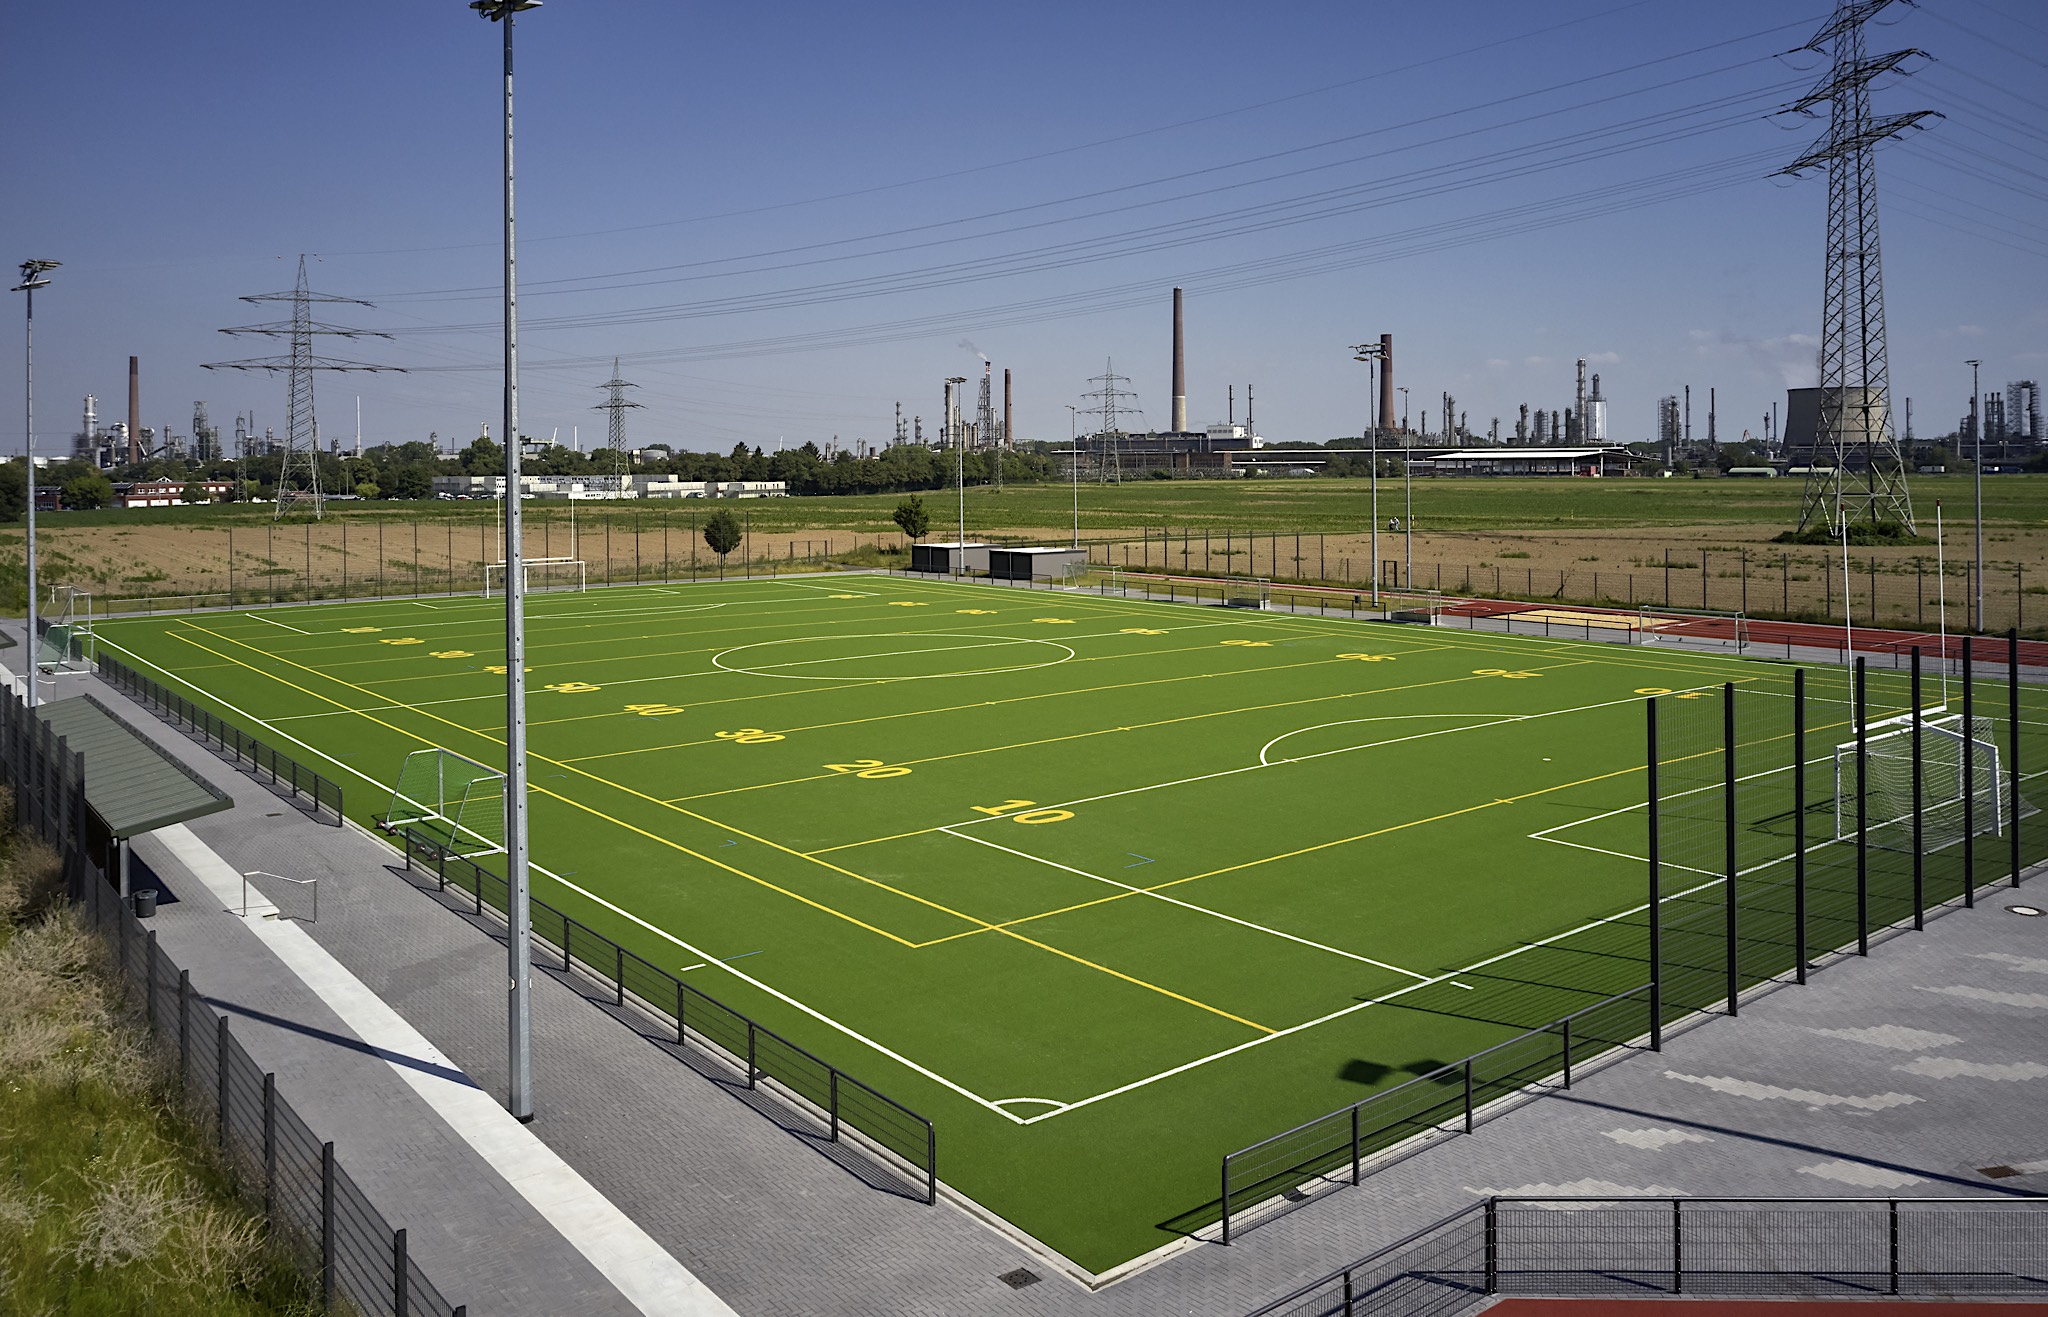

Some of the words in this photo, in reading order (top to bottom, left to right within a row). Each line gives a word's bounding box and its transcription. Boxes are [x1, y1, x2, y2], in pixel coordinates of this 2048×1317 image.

[544, 681, 601, 693] 50
[624, 704, 685, 716] 40
[715, 728, 786, 744] 30
[822, 759, 912, 779] 20
[969, 799, 1075, 824] 10
